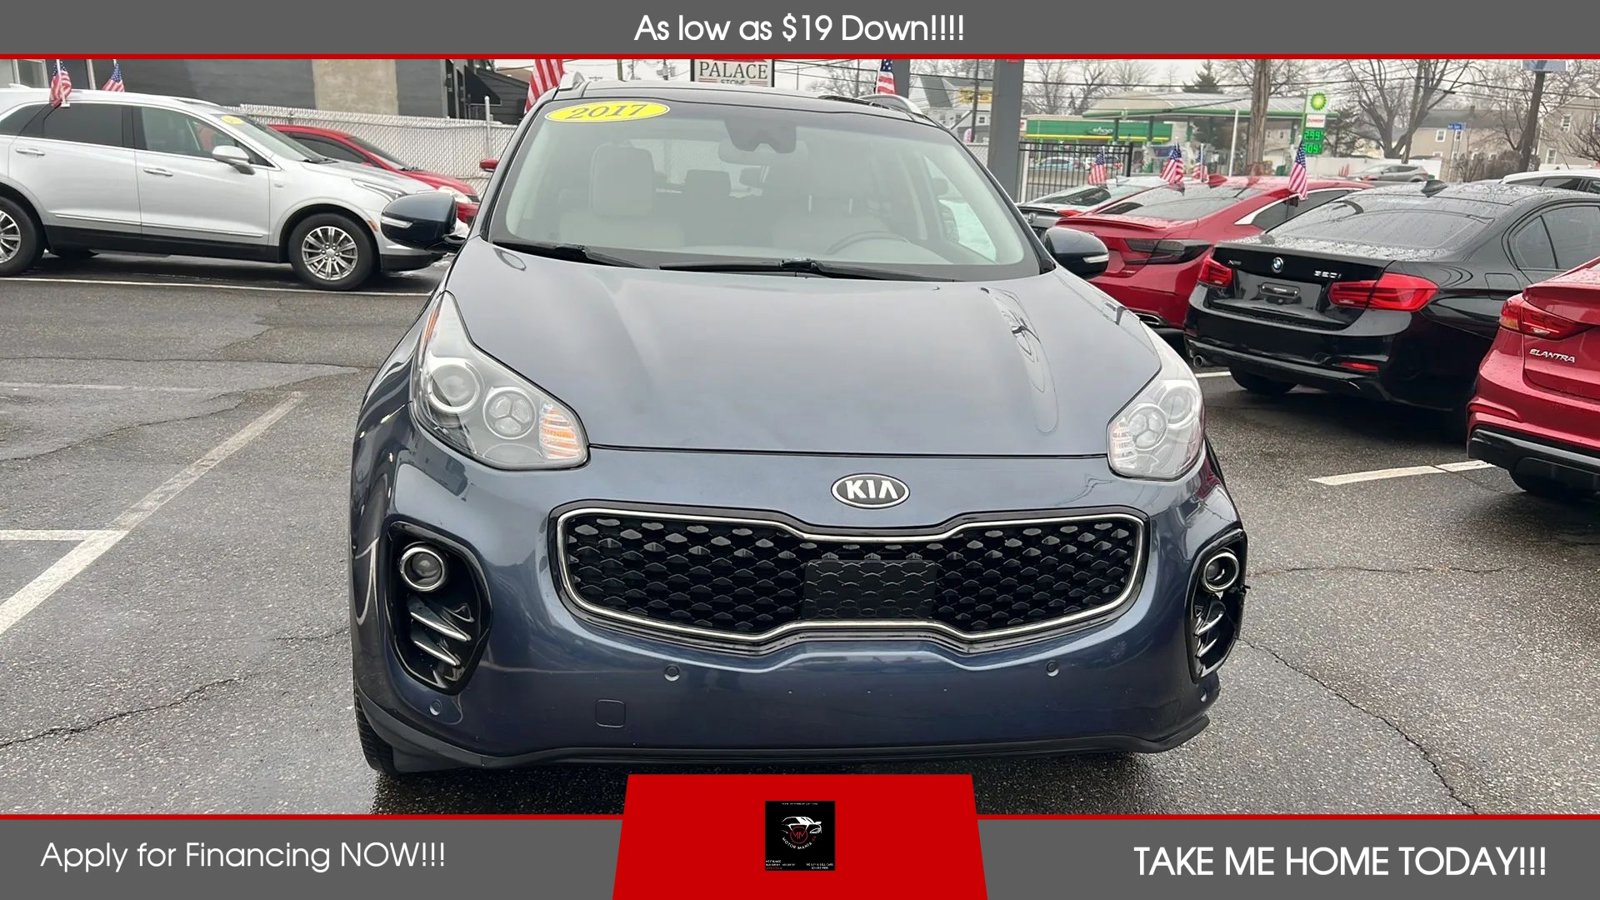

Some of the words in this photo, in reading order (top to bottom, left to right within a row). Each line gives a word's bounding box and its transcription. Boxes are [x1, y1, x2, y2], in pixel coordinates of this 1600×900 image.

[699, 61, 768, 80] PALACE
[565, 104, 648, 119] 2017
[1529, 348, 1576, 363] ELANTRA
[845, 479, 899, 500] KIA
